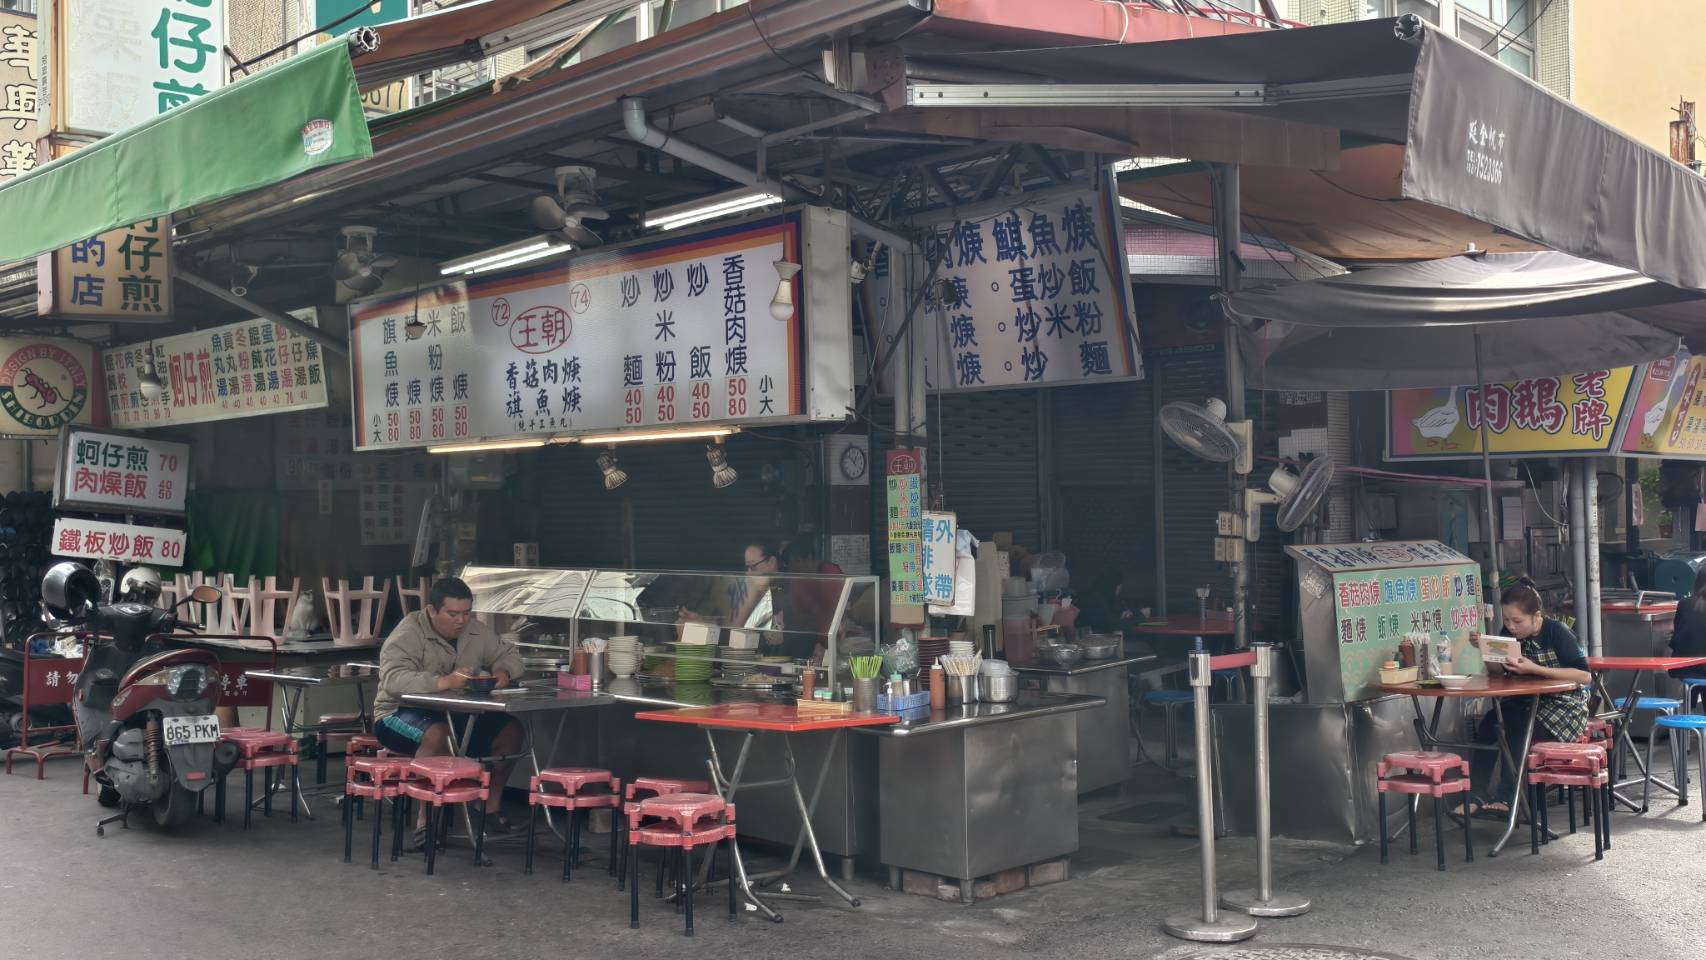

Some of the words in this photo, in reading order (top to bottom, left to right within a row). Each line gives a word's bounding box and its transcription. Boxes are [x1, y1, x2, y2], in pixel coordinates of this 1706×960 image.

[118, 218, 163, 313] 仔煎
[1008, 259, 1100, 303] 蛋炒飯
[492, 303, 509, 321] 72
[571, 290, 589, 308] 74
[518, 309, 566, 348] 王朝
[621, 274, 644, 387] 炒麵
[652, 268, 677, 384] 炒米粉
[687, 262, 713, 381] 炒飯
[1015, 301, 1104, 343] 炒米粉
[169, 347, 216, 408] 蚵仔煎
[624, 389, 642, 406] 40
[656, 385, 675, 402] 40
[692, 382, 710, 400] 40
[728, 378, 747, 396] 50
[759, 375, 774, 393] 小
[372, 414, 382, 425] 小
[387, 413, 399, 426] 50
[409, 410, 421, 424] 50
[431, 408, 444, 422] 50
[455, 406, 468, 420] 50
[625, 408, 642, 424] 50
[657, 405, 675, 421] 50
[692, 402, 710, 418] 50
[728, 399, 747, 416] 80
[759, 396, 774, 414] 大
[372, 430, 382, 443] 大
[387, 428, 399, 441] 80
[409, 426, 421, 439] 80
[432, 424, 444, 437] 80
[455, 422, 468, 436] 80
[76, 439, 150, 472] 蚵仔煎
[159, 454, 177, 473] 70
[74, 467, 148, 499] 肉燥飯
[158, 490, 172, 500] 50
[58, 528, 155, 559] 鐵板炒飯
[161, 540, 180, 559] 80
[935, 519, 954, 599] 外帶
[167, 725, 192, 740] 865
